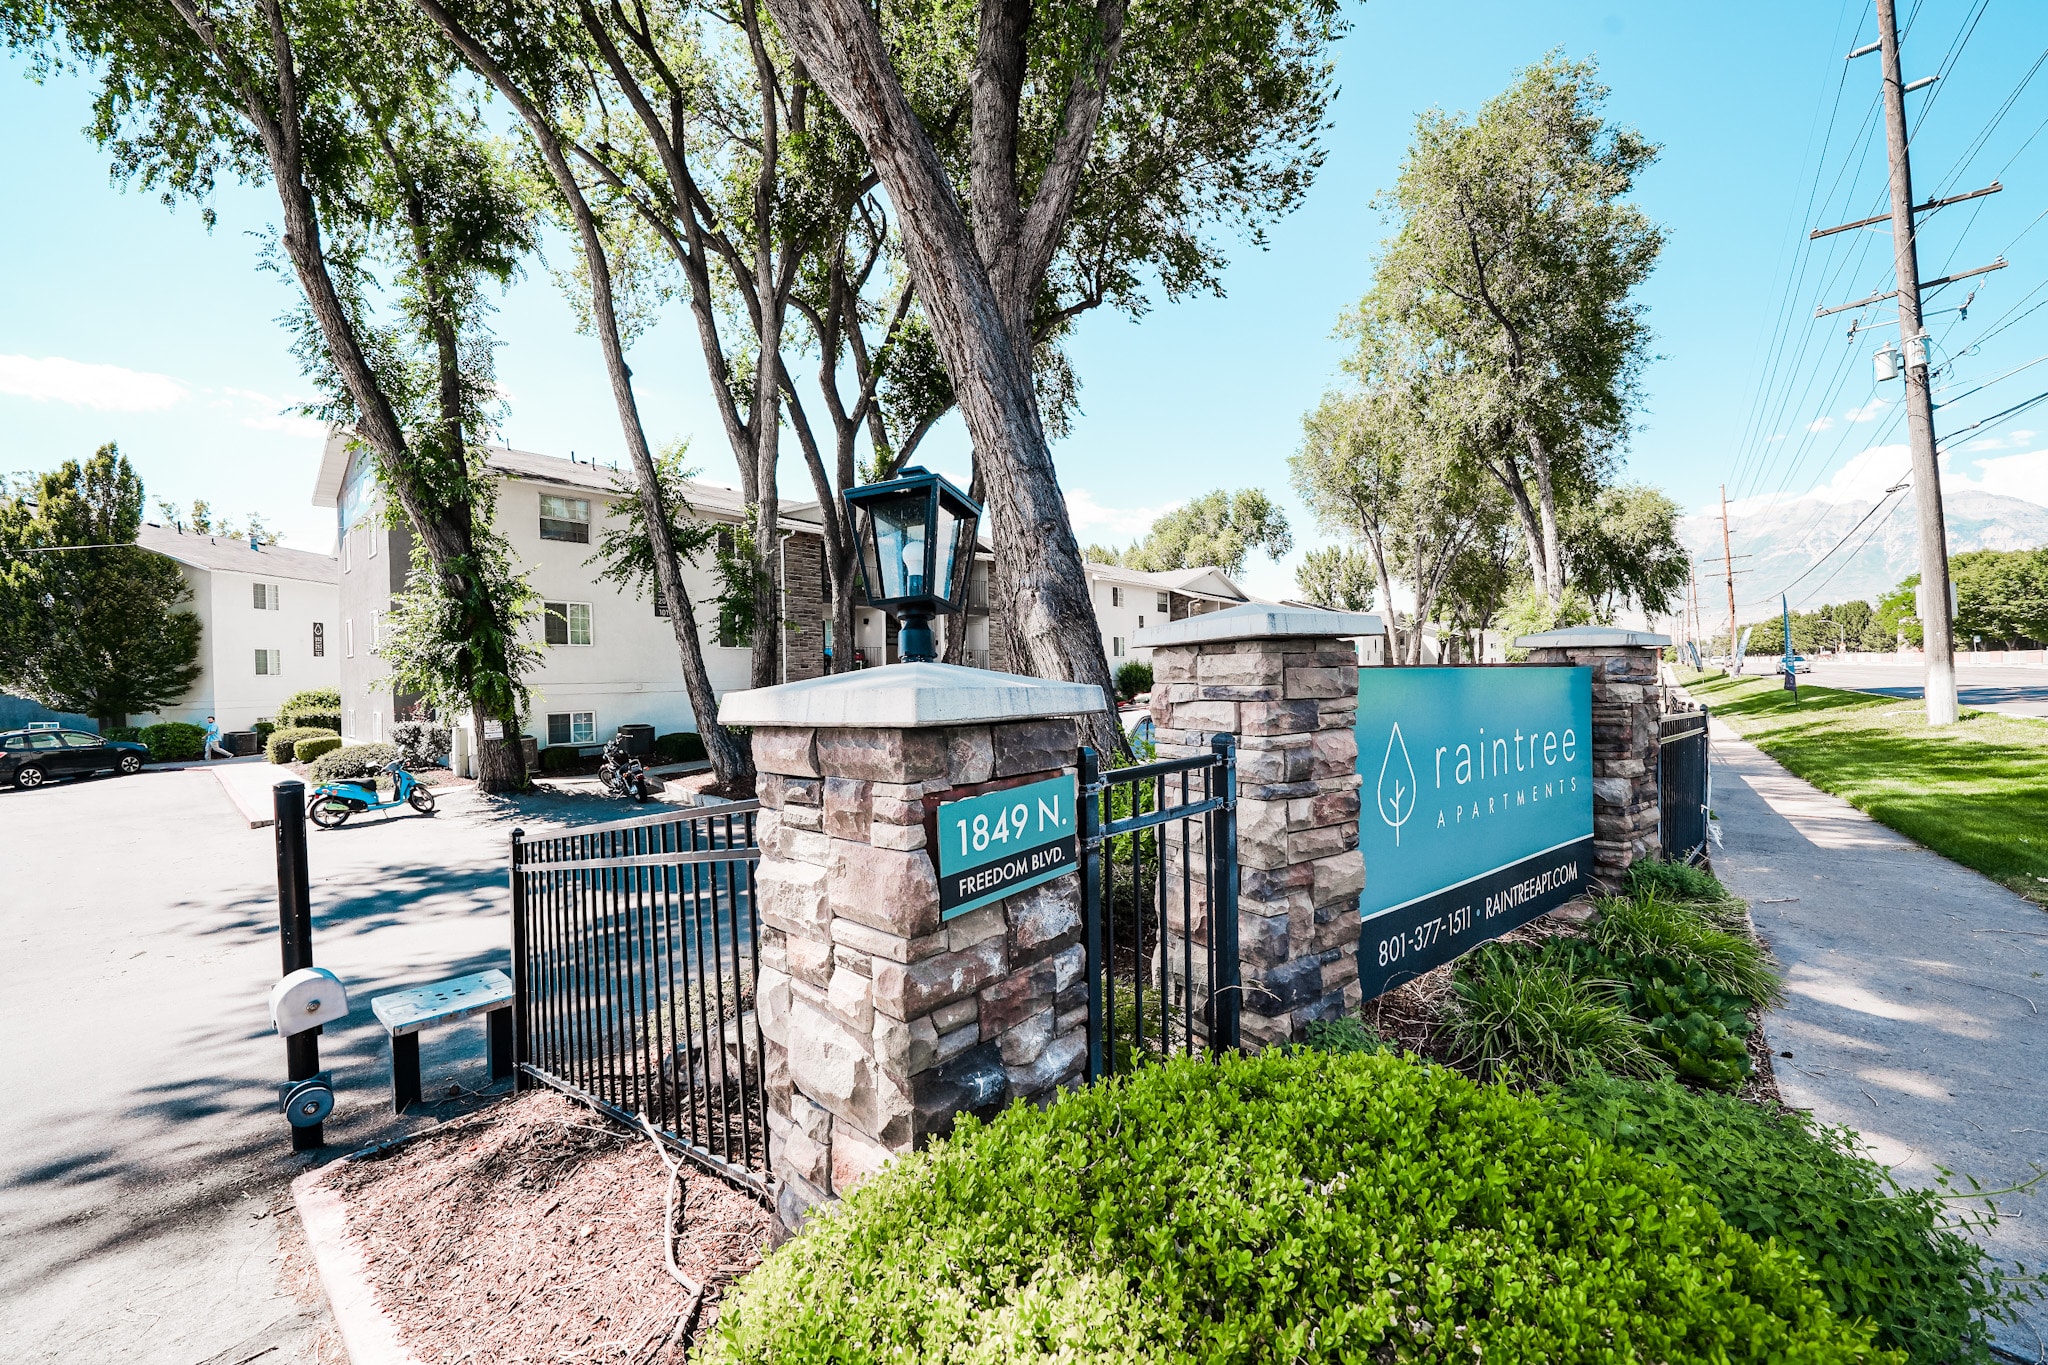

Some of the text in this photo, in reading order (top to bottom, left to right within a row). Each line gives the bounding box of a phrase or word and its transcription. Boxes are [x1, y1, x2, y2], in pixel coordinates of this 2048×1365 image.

[1435, 727, 1576, 788] raintree
[956, 794, 1067, 856] 1849 N.
[1437, 777, 1577, 828] APARTMENTS
[959, 846, 1065, 897] FREEDOM BLVD.
[1379, 861, 1578, 967] 801-377-1511 RAINTREEAPT.COM
